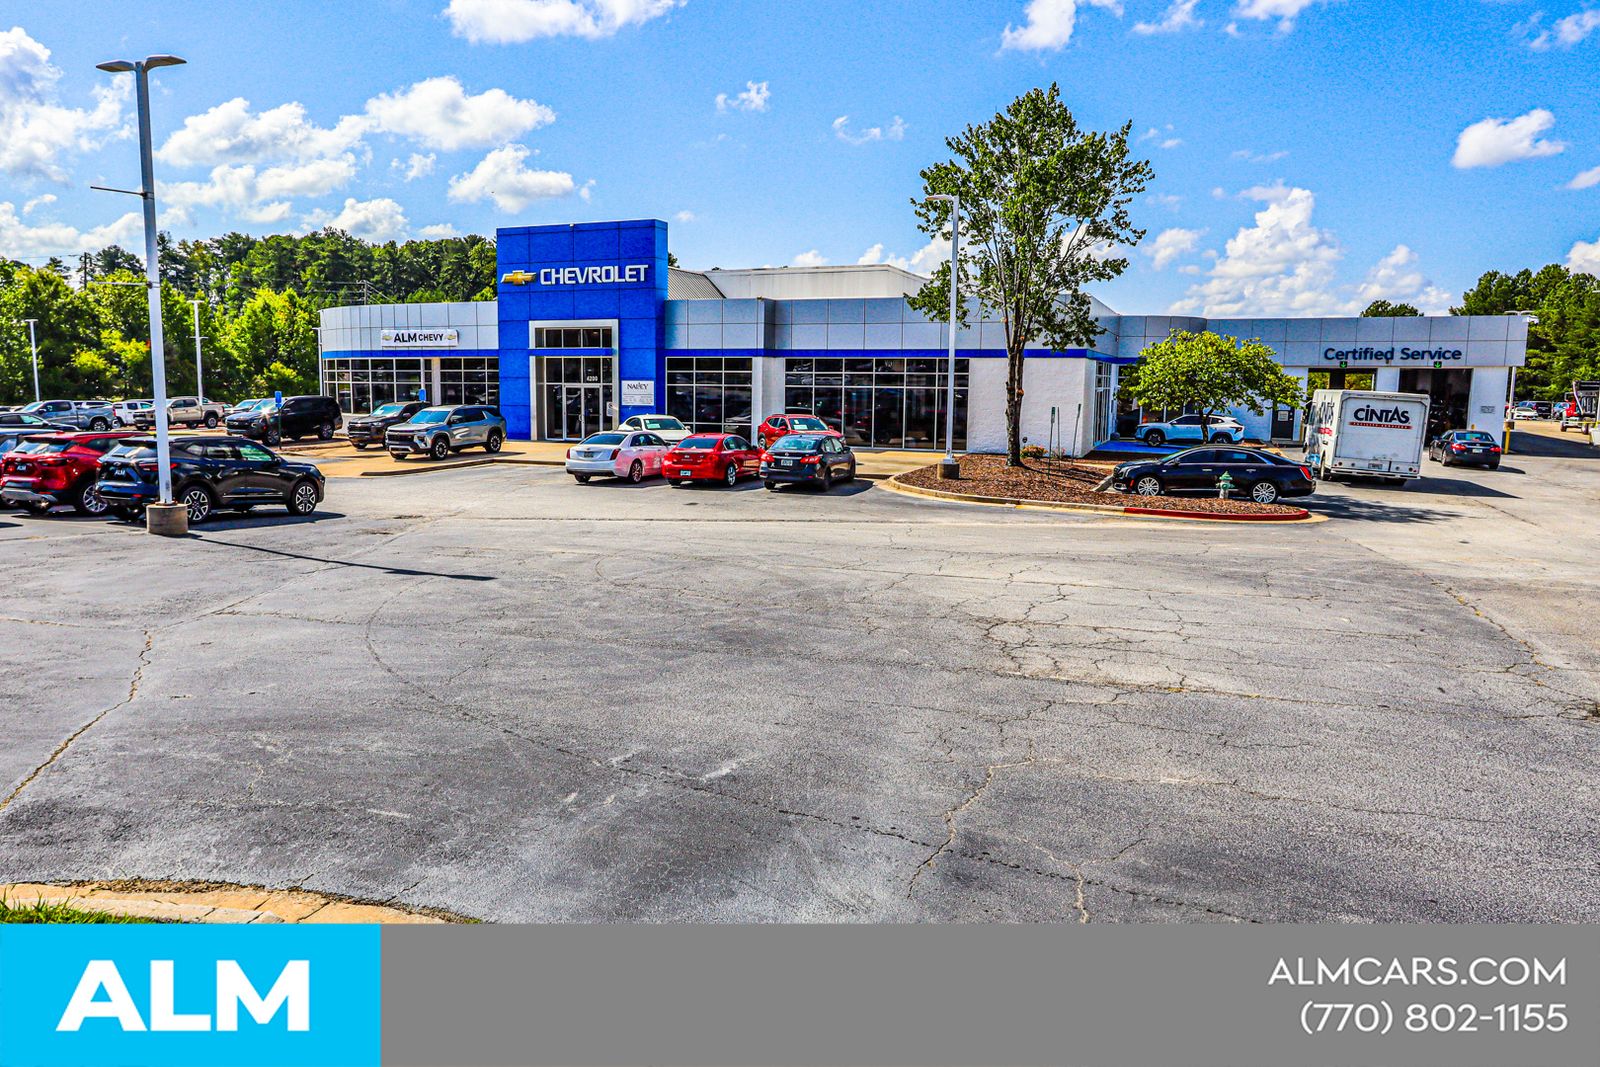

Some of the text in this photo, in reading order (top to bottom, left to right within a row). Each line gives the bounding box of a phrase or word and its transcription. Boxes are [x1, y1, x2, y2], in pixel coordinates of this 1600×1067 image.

[540, 264, 649, 285] CHEVROLET
[393, 332, 444, 343] ALM CHEVY
[1323, 347, 1462, 361] Certified Service
